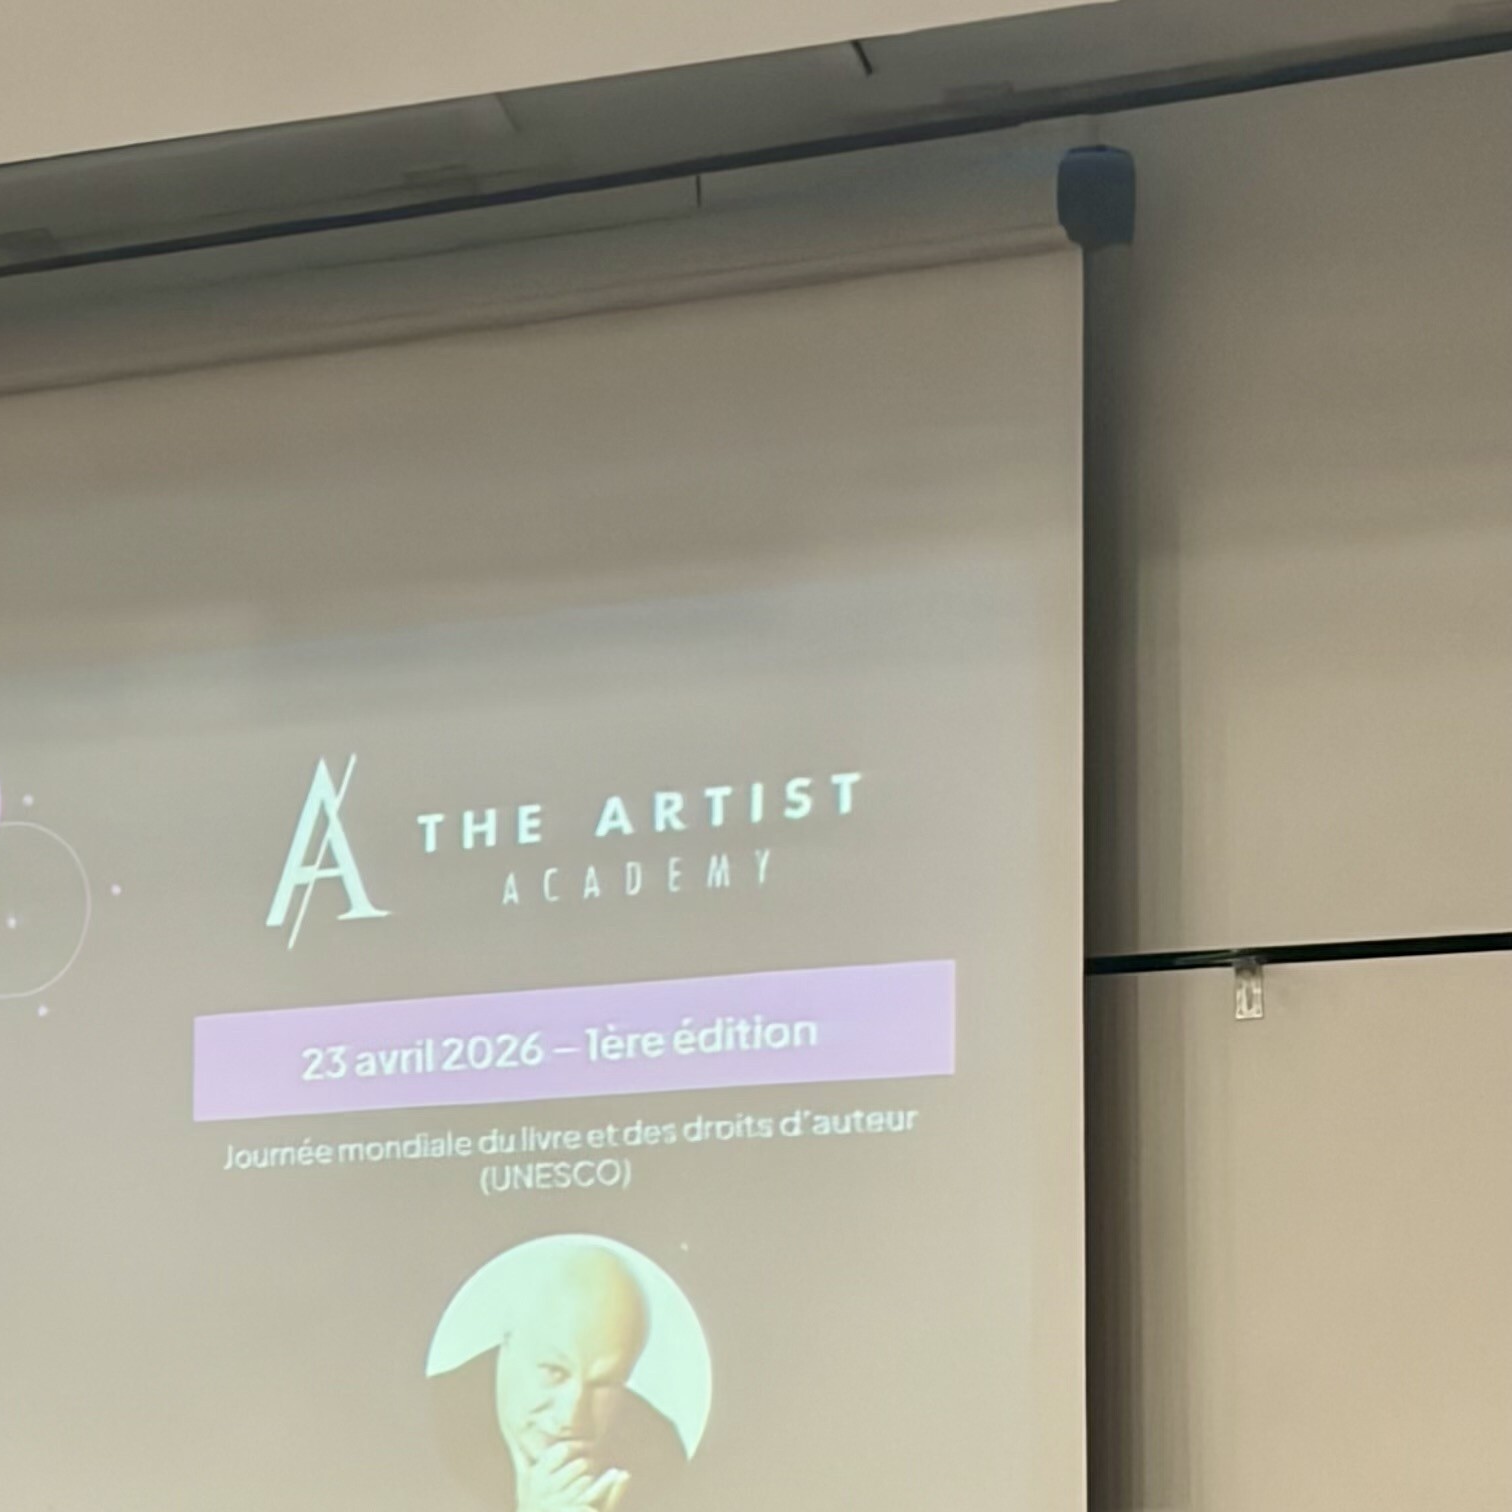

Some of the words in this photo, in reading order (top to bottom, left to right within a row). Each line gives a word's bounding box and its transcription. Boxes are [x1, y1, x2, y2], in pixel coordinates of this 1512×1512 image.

[416, 803, 543, 853] THE
[594, 771, 862, 838] ARTIST
[501, 848, 771, 905] ACADEMY
[301, 1045, 348, 1081] 23
[354, 1038, 435, 1077] avril
[441, 1031, 545, 1071] 2026
[585, 1023, 665, 1061] 1ère
[672, 1014, 818, 1055] édition
[223, 1137, 333, 1170] Journée
[338, 1130, 473, 1164] mondiale
[477, 1128, 516, 1155] du
[520, 1125, 582, 1152] livre
[586, 1124, 619, 1149] et
[622, 1119, 677, 1147] des
[682, 1112, 774, 1143] droits
[779, 1109, 919, 1138] d'auteur
[479, 1157, 632, 1196] (UNESCO)
